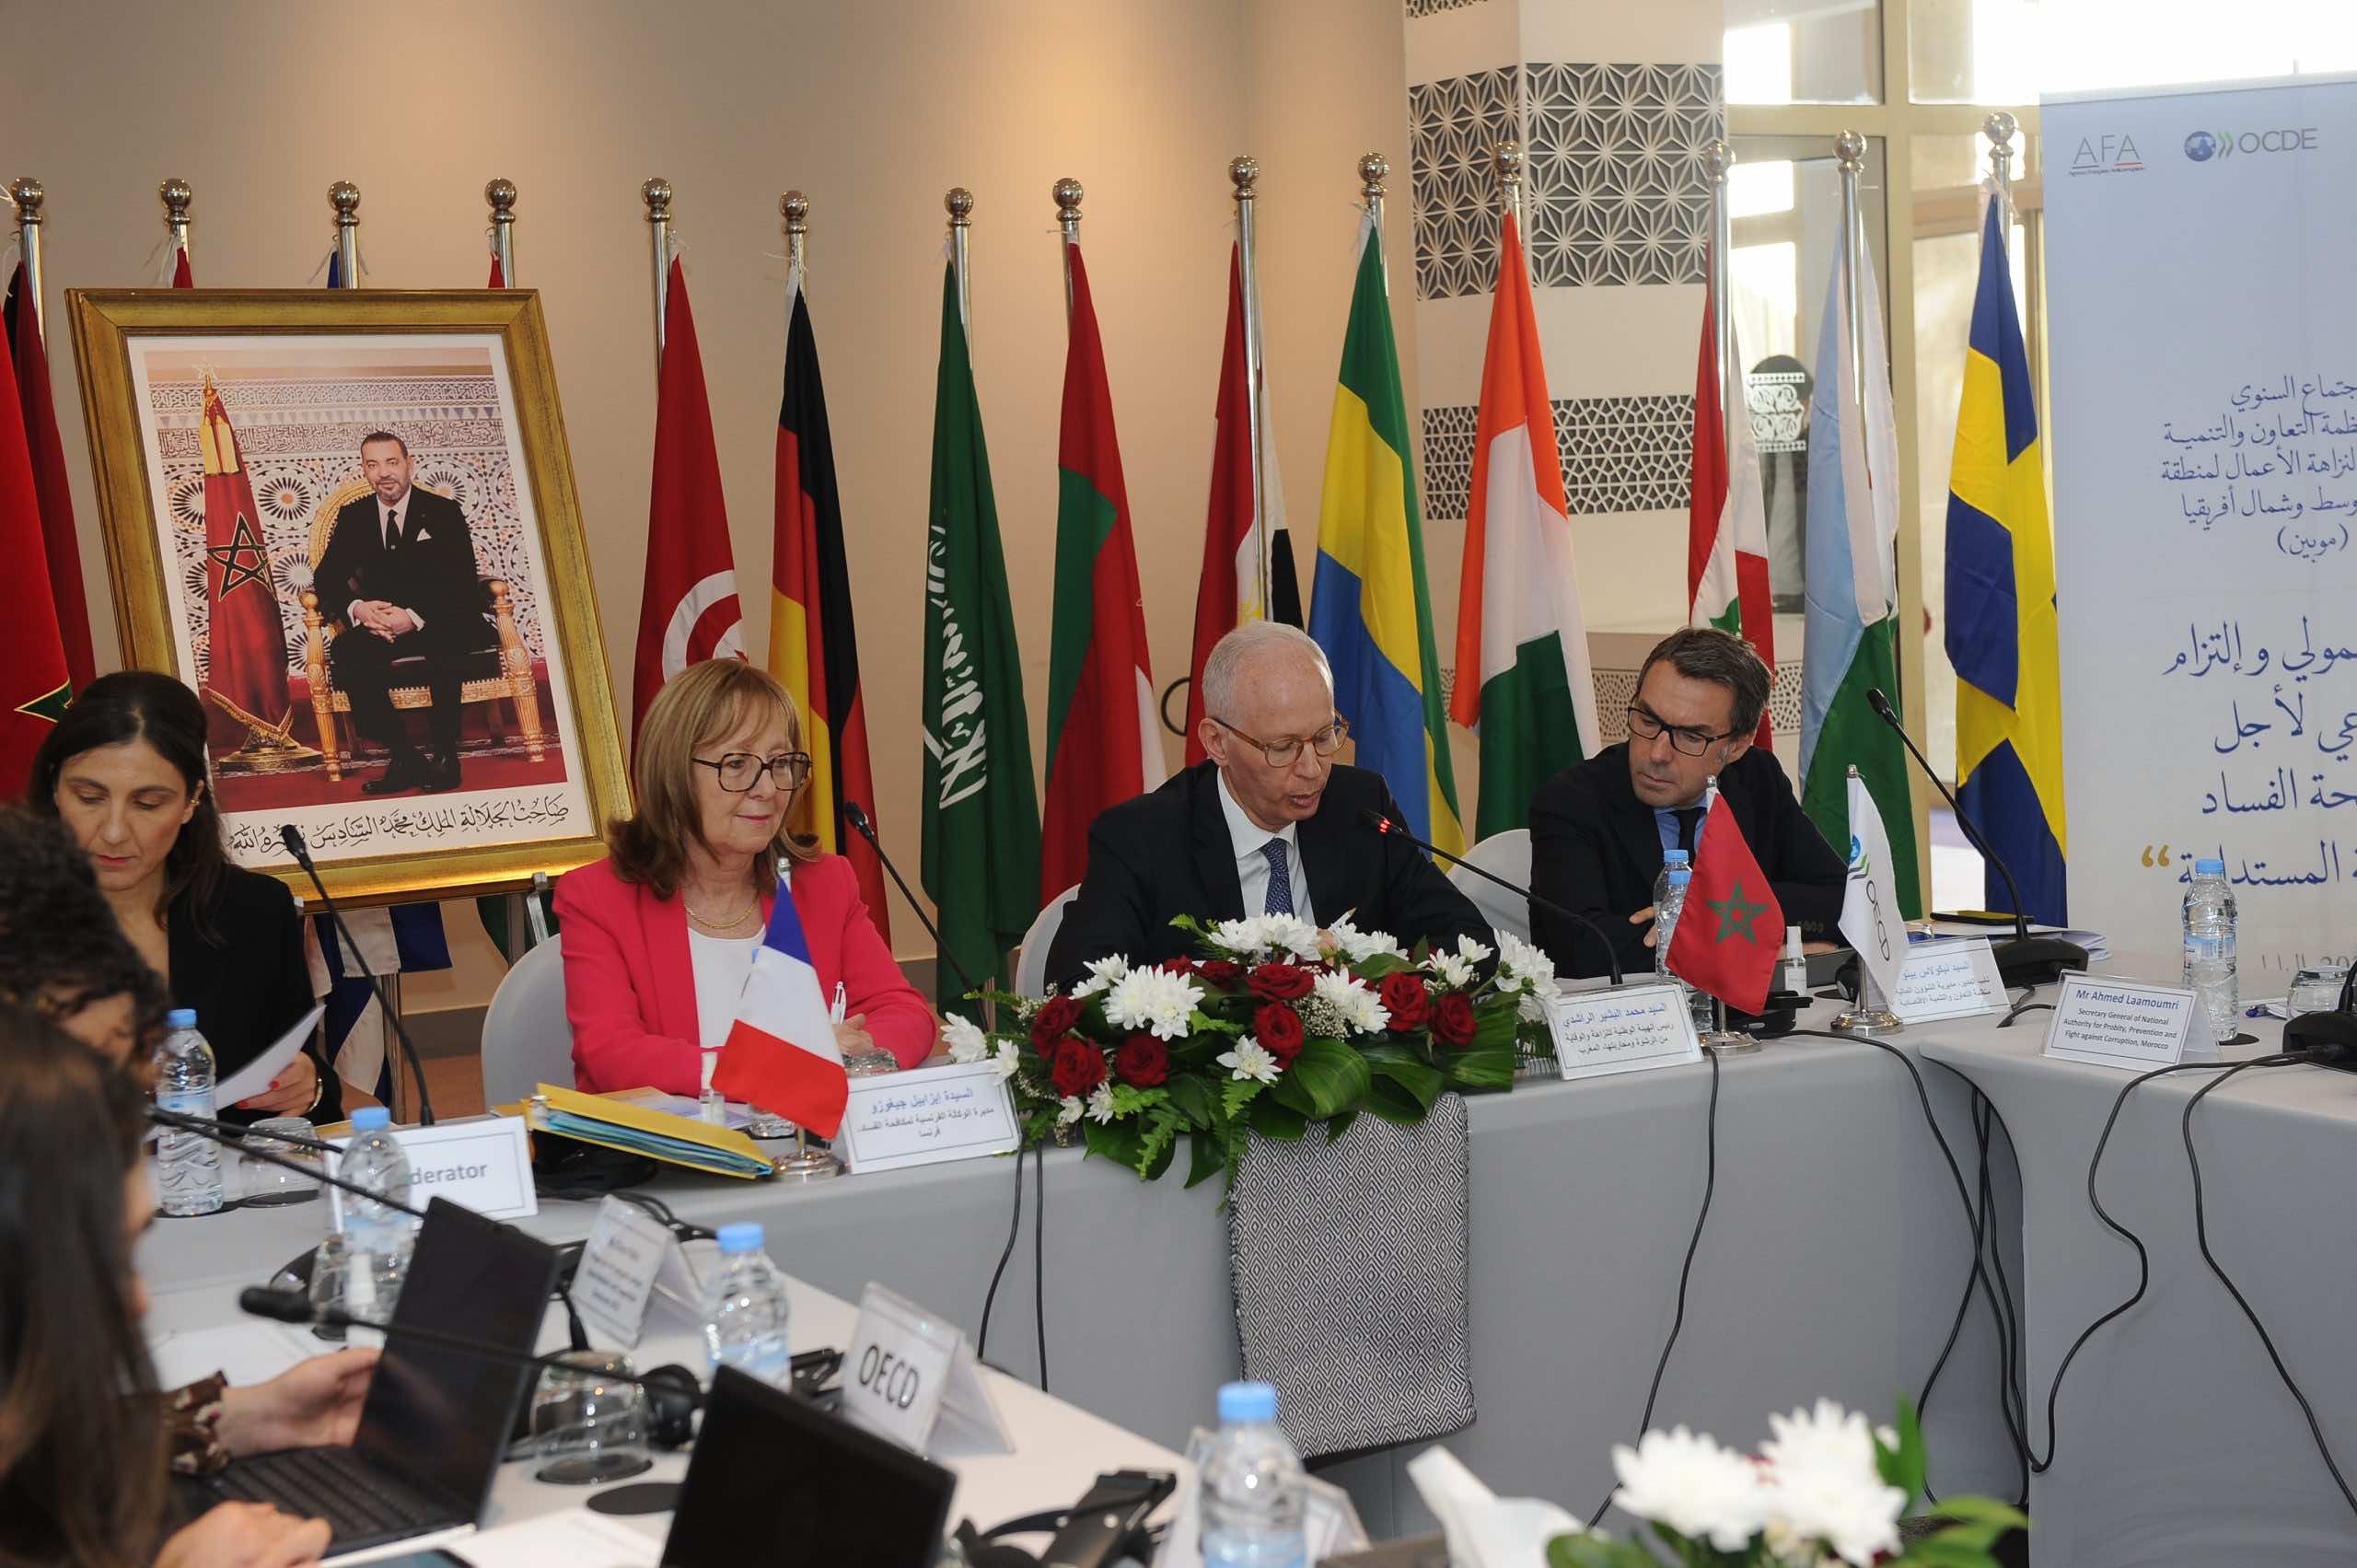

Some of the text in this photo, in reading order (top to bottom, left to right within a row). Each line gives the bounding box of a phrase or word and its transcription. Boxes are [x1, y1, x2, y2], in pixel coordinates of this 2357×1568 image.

[2073, 134, 2141, 164] AFA
[2239, 128, 2319, 154] OCDE
[2232, 375, 2295, 412] السنوي
[2164, 413, 2245, 449] والتنمية
[2251, 413, 2315, 446] التعاون
[2162, 452, 2219, 481] لمنطقة
[2225, 444, 2300, 480] الأعمال
[2181, 484, 2235, 530] أفريقيا
[2242, 489, 2304, 519] وشمال
[2282, 615, 2357, 682] مولي
[2214, 684, 2303, 754] لأجل
[2202, 765, 2298, 814] الفساد
[2178, 839, 2340, 886] المستداة
[1866, 879, 1890, 961] OECD
[2076, 989, 2180, 1010] Mr Ahmed Laamoumri
[2078, 1008, 2107, 1019] Secretary
[2108, 1012, 2132, 1021] General
[2142, 1016, 2169, 1025] National
[2063, 1018, 2093, 1029] Authority
[2129, 1026, 2163, 1038] Prevention
[2165, 1030, 2177, 1039] and
[2065, 1030, 2080, 1040] Fight
[2081, 1033, 2103, 1042] against
[2141, 1040, 2169, 1050] Morocco
[411, 1164, 488, 1185] derator
[859, 1345, 920, 1410] OECD
